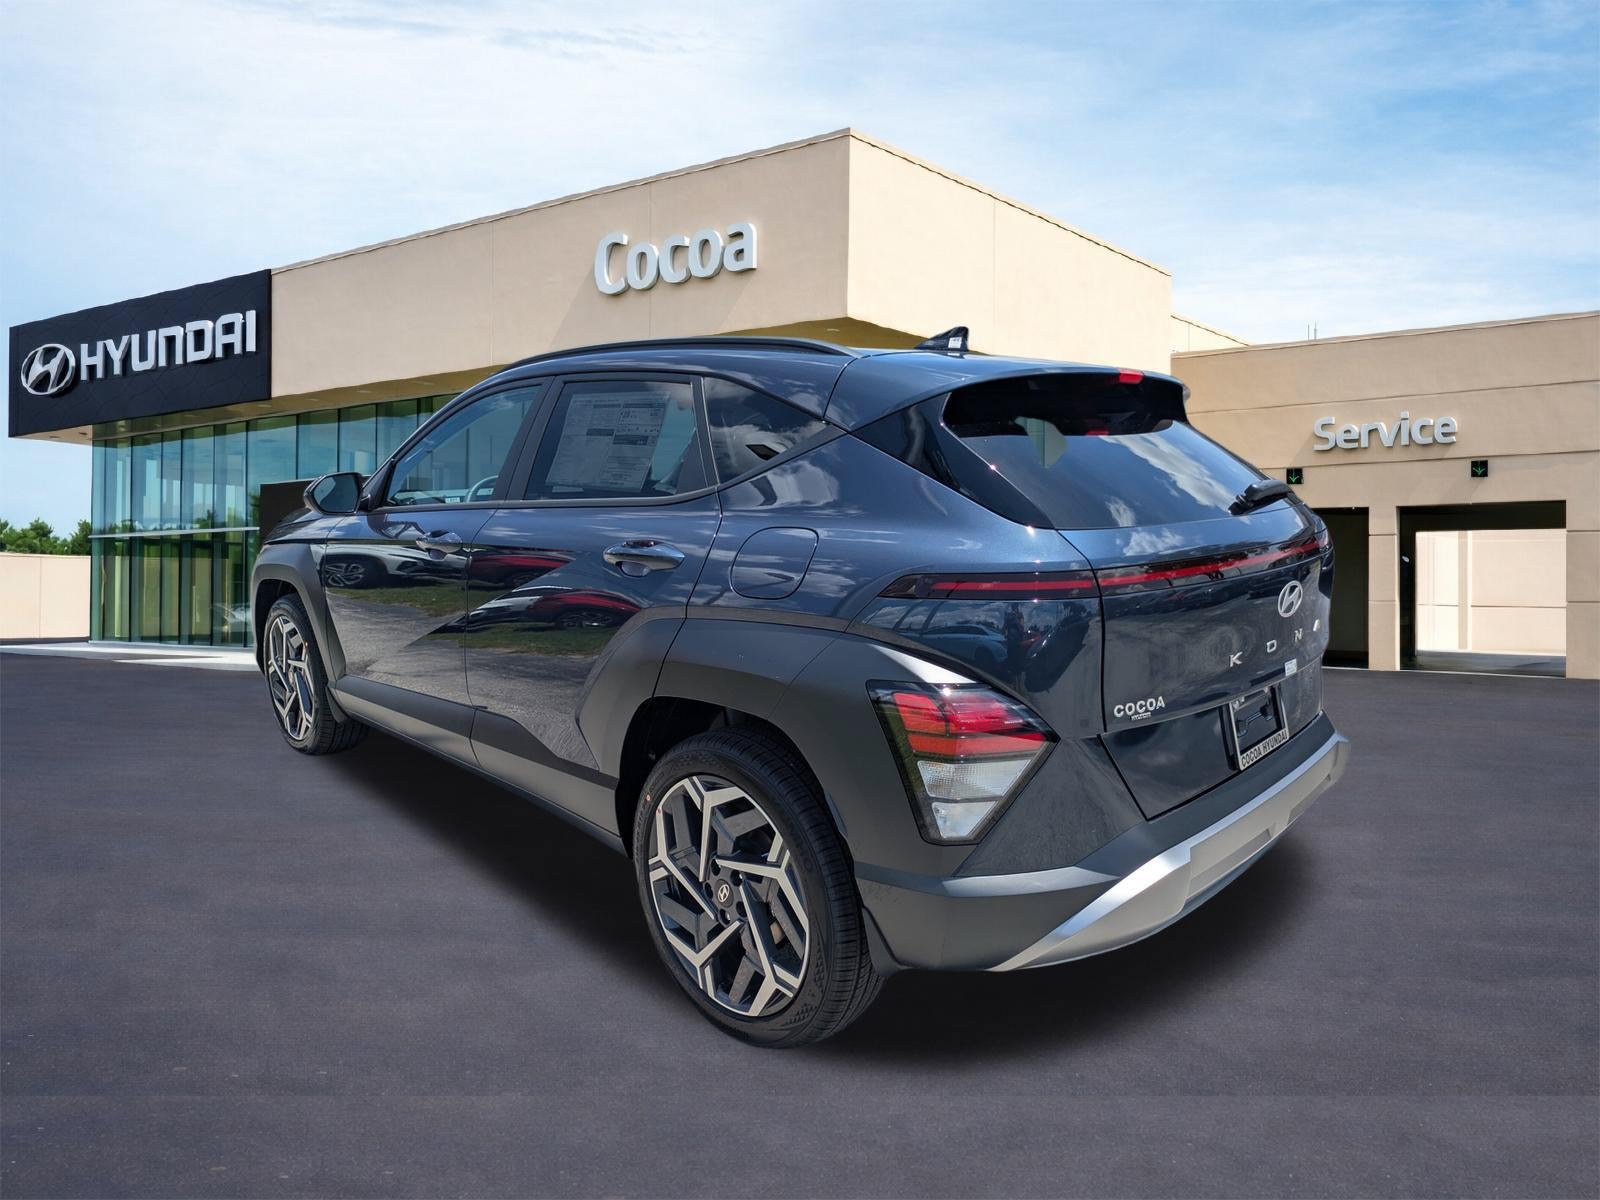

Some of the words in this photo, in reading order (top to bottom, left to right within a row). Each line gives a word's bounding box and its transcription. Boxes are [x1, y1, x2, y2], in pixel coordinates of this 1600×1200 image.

[594, 223, 757, 295] Cocoa
[80, 310, 257, 381] HYUNDAI
[1312, 411, 1458, 451] Service
[1113, 695, 1166, 718] COCOA
[1241, 746, 1263, 767] COCOA
[1262, 729, 1288, 754] HYUNDAI
